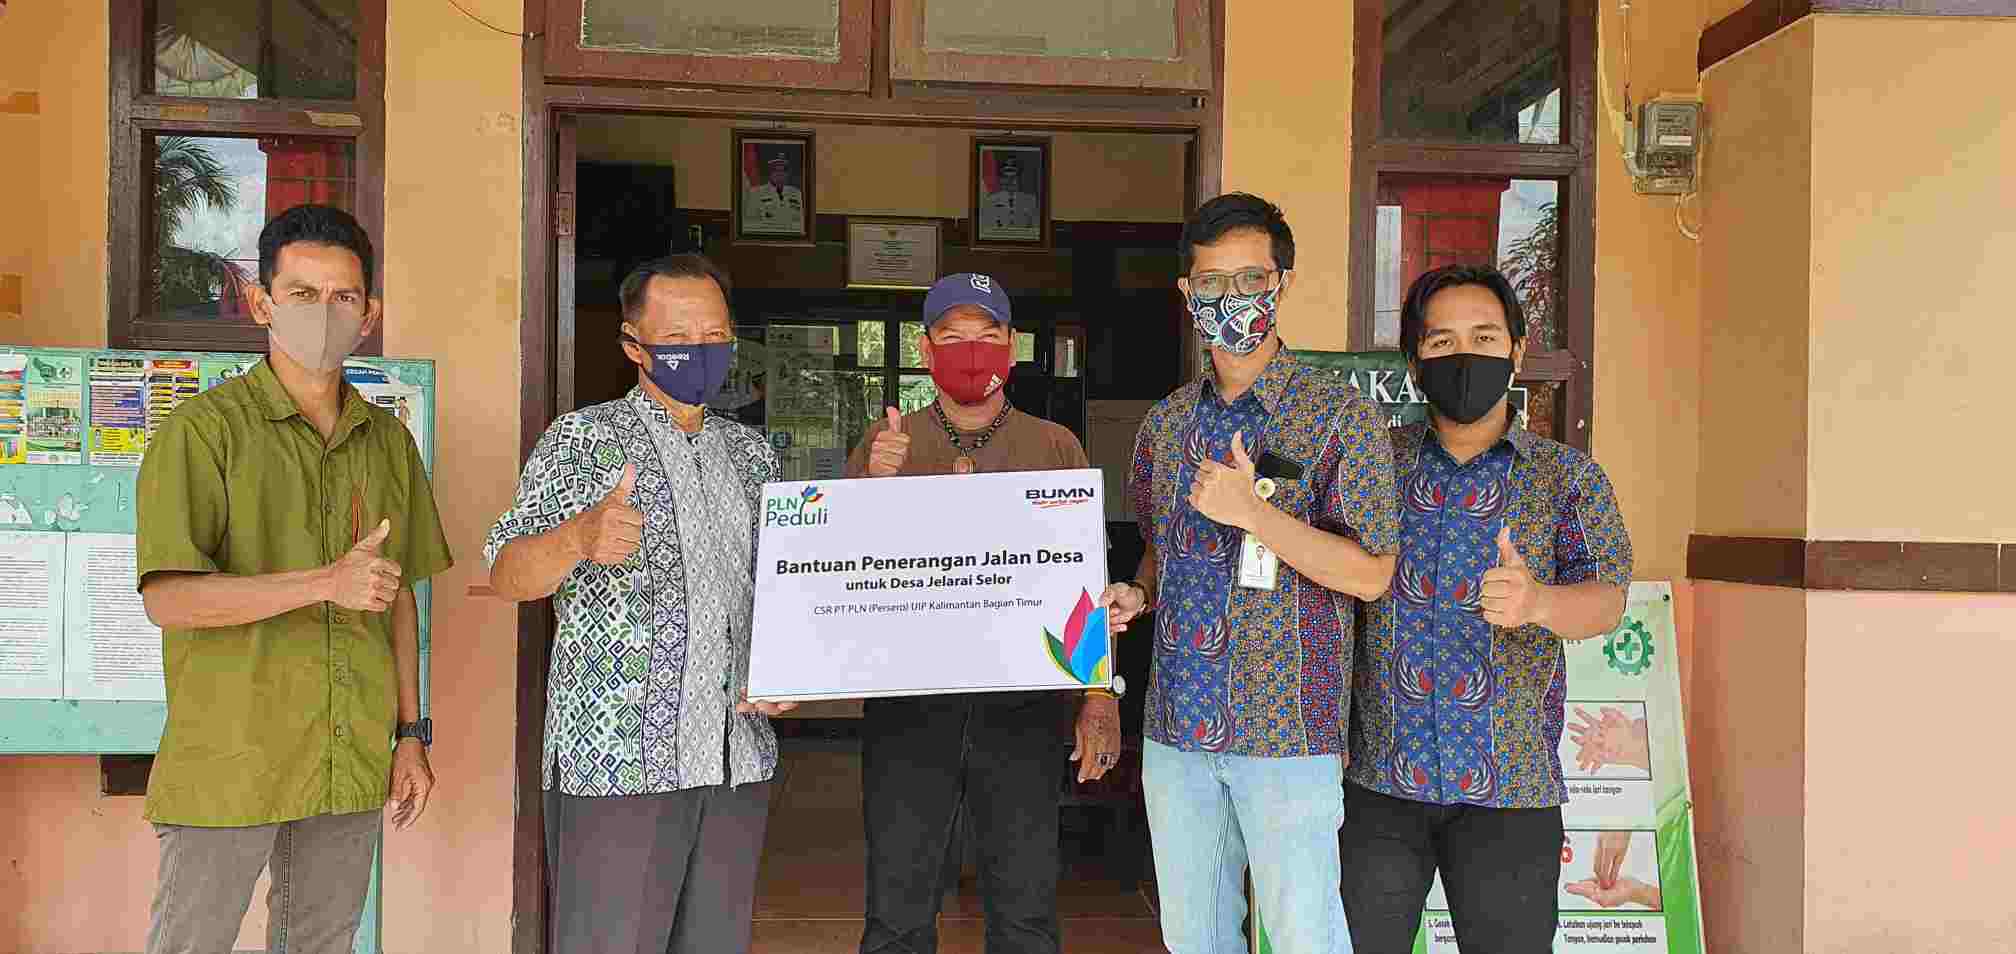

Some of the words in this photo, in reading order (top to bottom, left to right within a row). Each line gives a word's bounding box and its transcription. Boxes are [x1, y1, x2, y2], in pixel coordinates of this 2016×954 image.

[1025, 488, 1094, 499] BUMN
[767, 498, 798, 510] PLN
[766, 508, 828, 527] Peduli
[776, 560, 857, 575] Bantuan
[861, 555, 976, 571] Penerangan
[981, 550, 1031, 565] Jalan
[1037, 550, 1084, 564] Desa
[845, 578, 887, 590] untuk
[890, 577, 924, 589] Desa
[927, 574, 973, 587] Jelarai
[976, 573, 1013, 585] Selor
[814, 606, 834, 614] CSR
[834, 605, 847, 613] PT
[848, 604, 868, 613] PLN
[929, 600, 981, 610] Kalimantan
[983, 599, 1014, 610] Bagian
[1015, 598, 1043, 608] Timur
